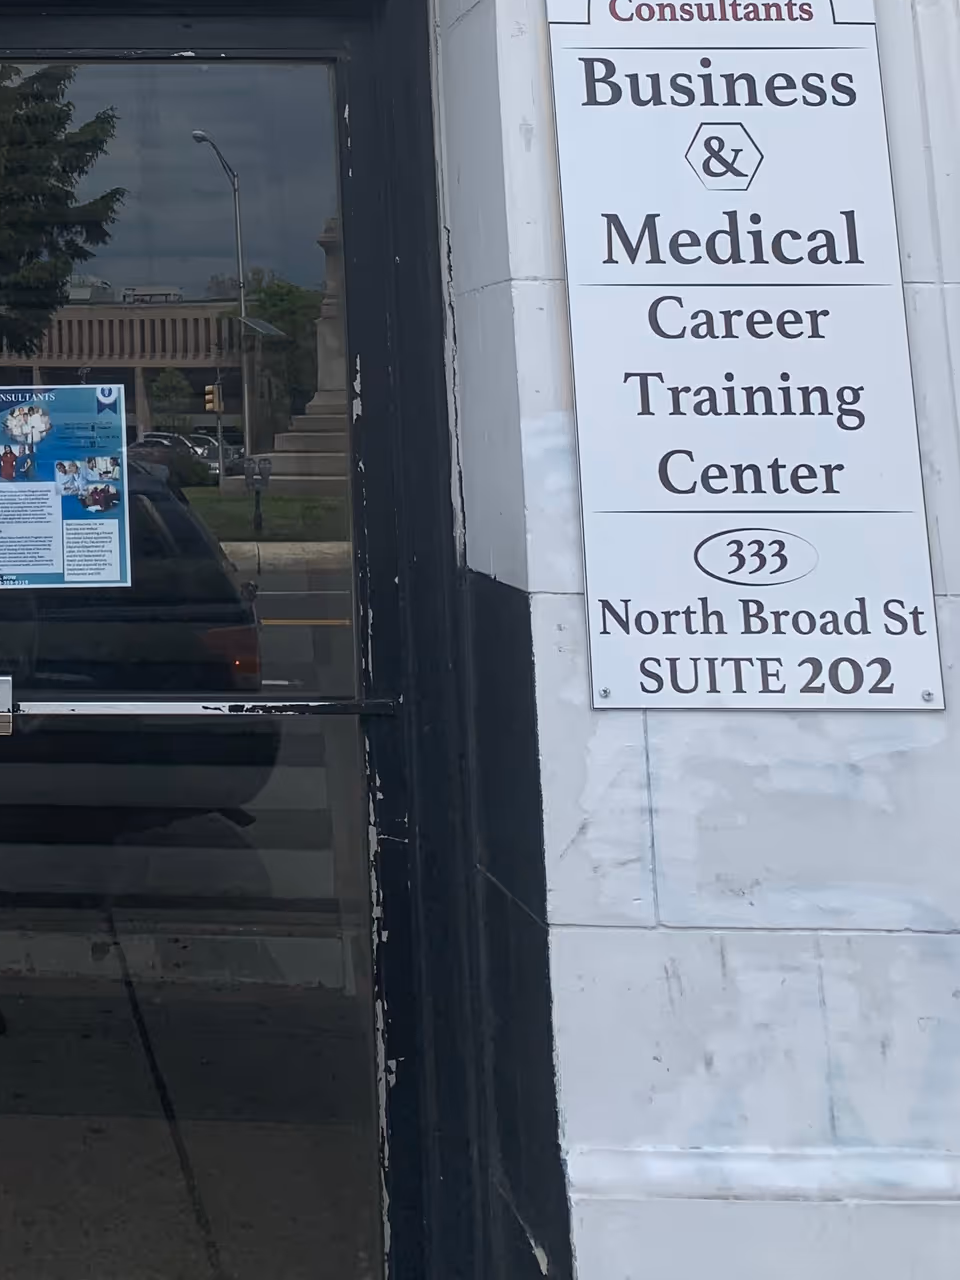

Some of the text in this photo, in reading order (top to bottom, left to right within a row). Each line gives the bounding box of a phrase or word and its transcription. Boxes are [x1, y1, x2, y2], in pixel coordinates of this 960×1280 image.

[578, 57, 856, 106] Business
[699, 133, 751, 179] &
[601, 210, 864, 264] Medical
[648, 296, 829, 339] Career
[624, 372, 865, 430] Training
[659, 450, 844, 494] Center
[727, 540, 787, 574] 333
[598, 597, 927, 635] North Broad St
[640, 657, 894, 694] SUITE 202
